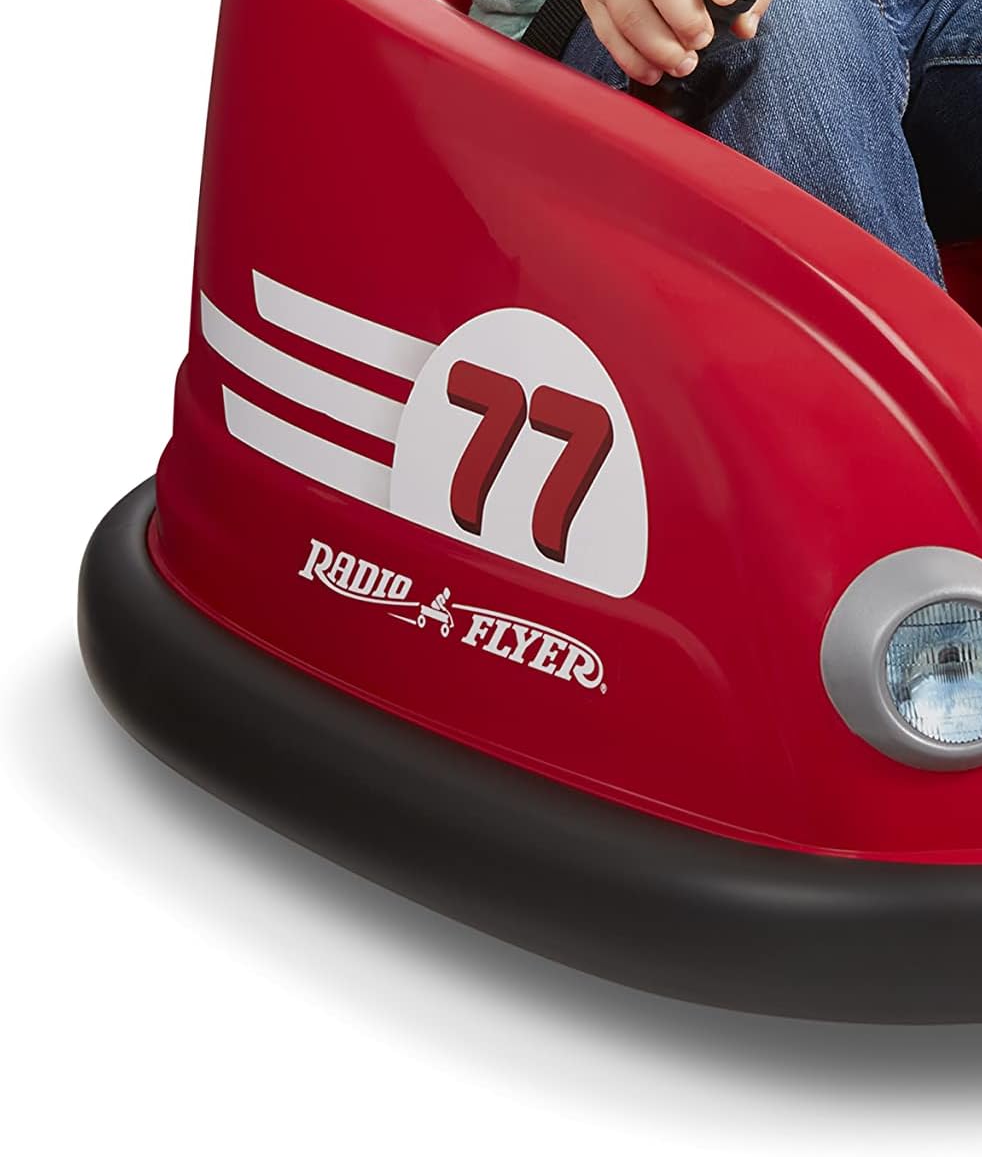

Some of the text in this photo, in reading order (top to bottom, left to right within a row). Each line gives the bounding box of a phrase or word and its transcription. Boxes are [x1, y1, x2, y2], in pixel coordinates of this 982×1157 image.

[446, 360, 614, 564] 77
[298, 538, 605, 690] RADIO FLYER
